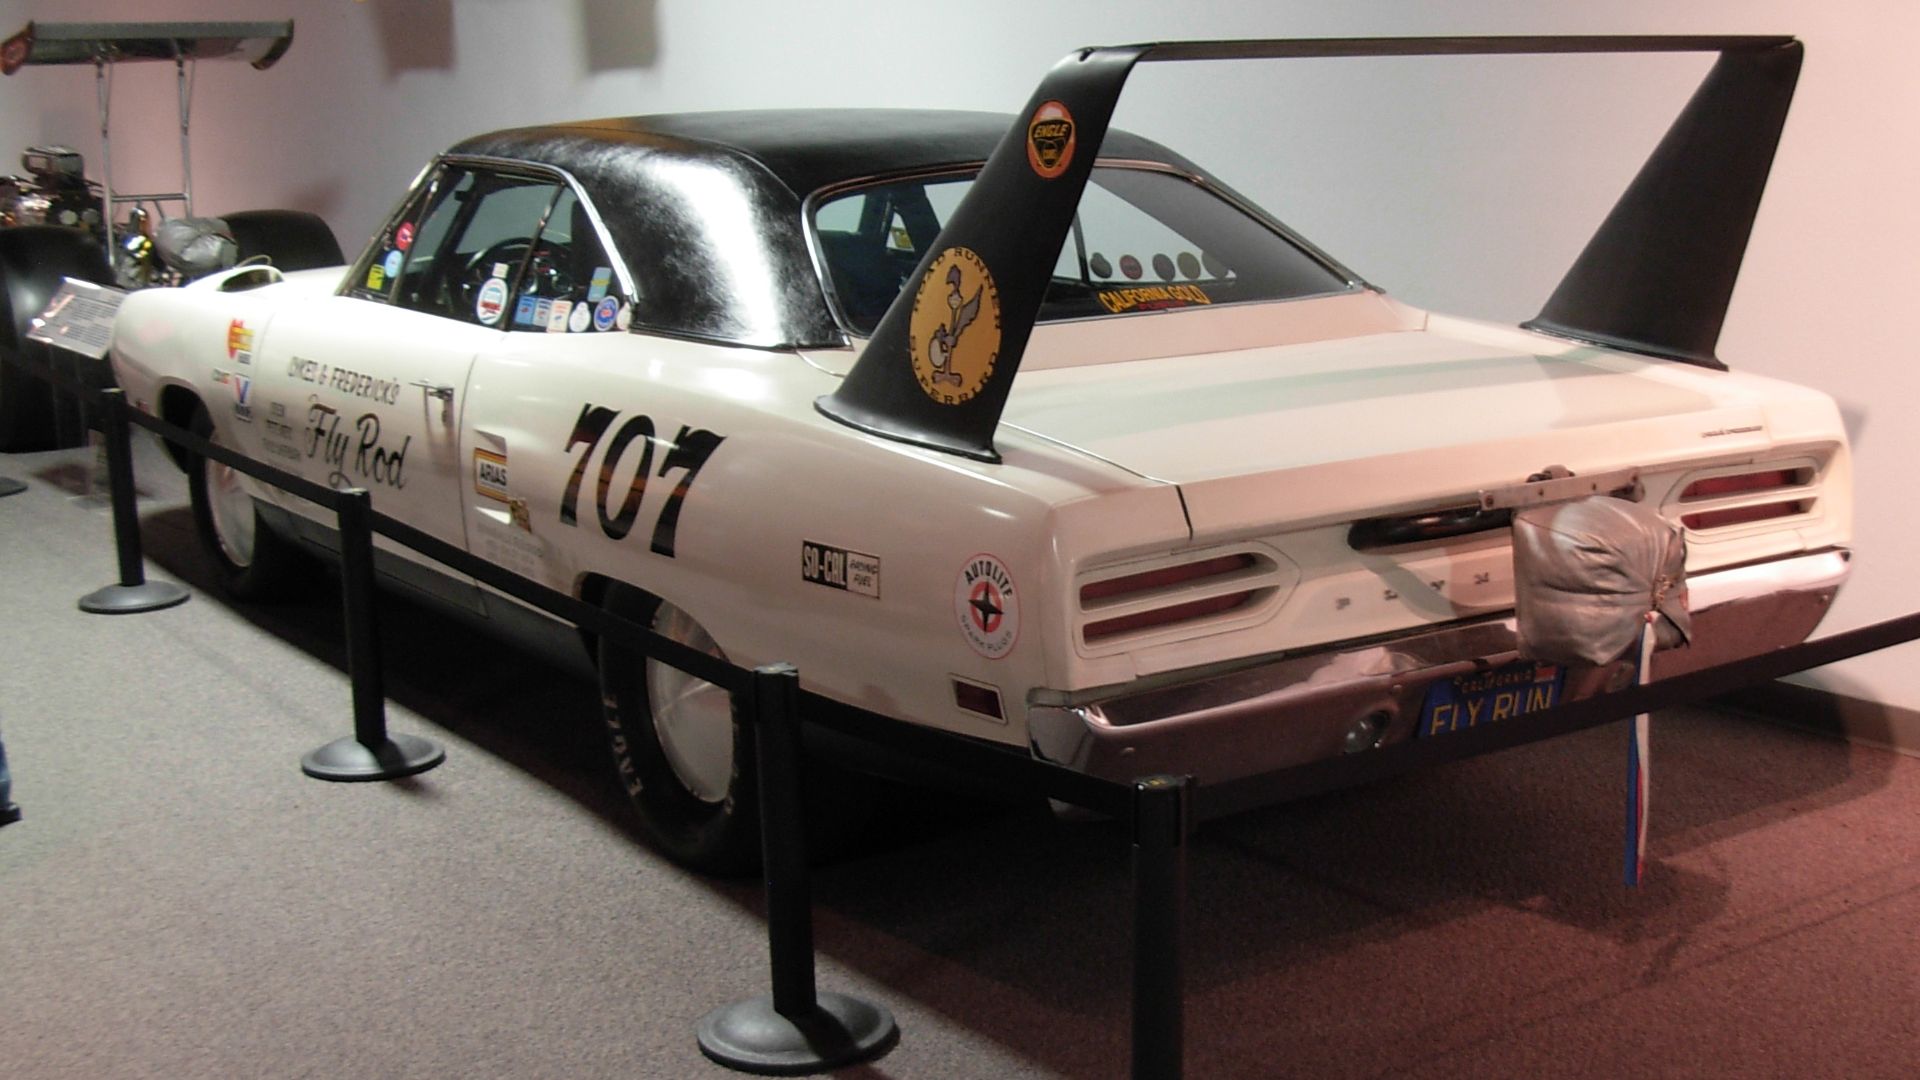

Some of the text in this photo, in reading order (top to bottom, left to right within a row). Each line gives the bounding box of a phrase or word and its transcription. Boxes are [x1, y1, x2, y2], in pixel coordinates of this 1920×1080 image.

[1034, 123, 1070, 138] ENGLE
[1098, 286, 1170, 313] CALIFORNIA
[1166, 284, 1212, 305] GOLD
[304, 393, 411, 490] Fly Rod
[480, 462, 507, 487] ARIAS
[559, 402, 729, 559] 707
[803, 545, 847, 586] SO-CAL
[964, 560, 1014, 598] AUTOLITE
